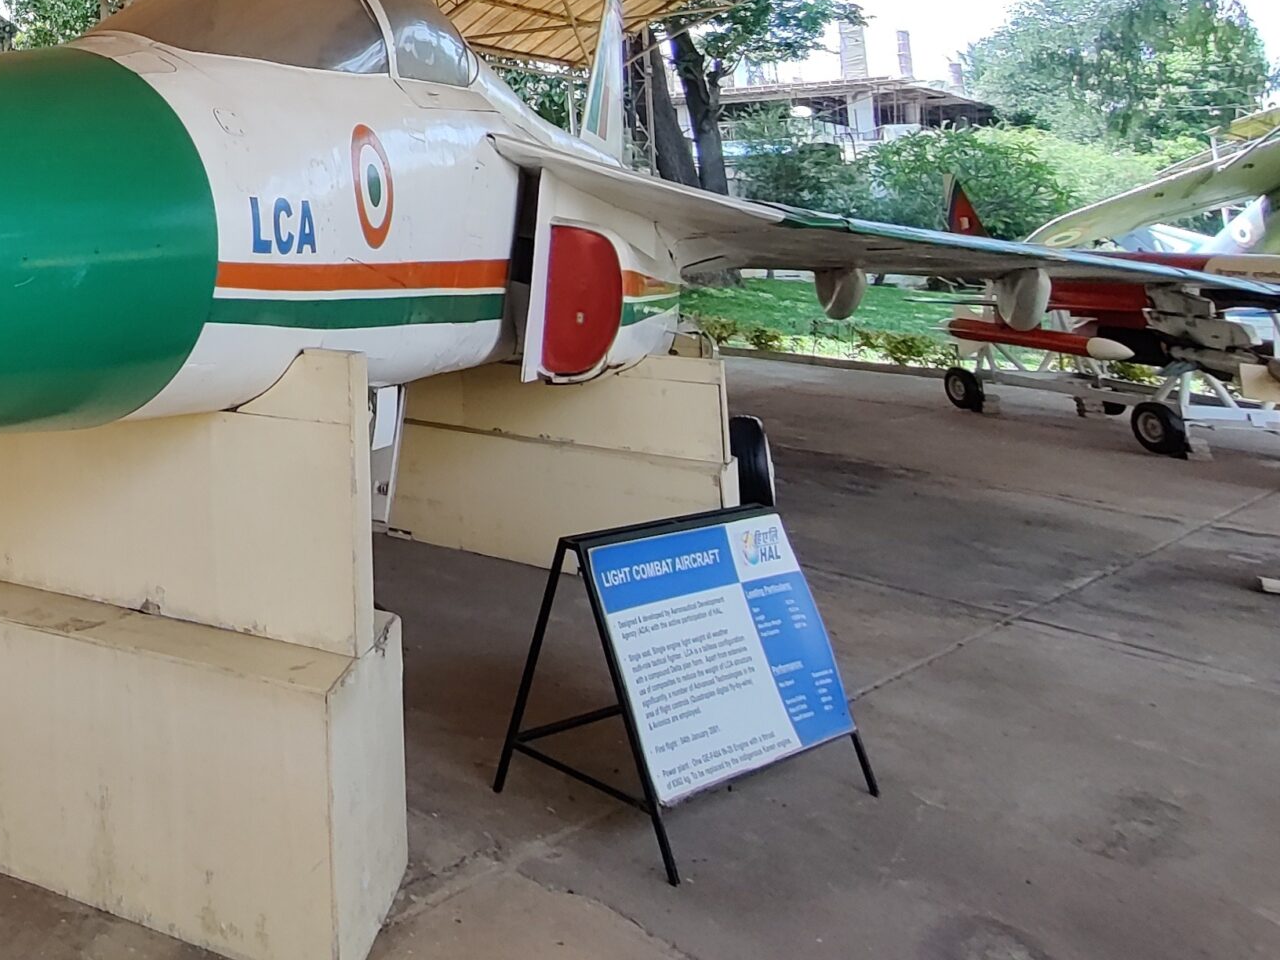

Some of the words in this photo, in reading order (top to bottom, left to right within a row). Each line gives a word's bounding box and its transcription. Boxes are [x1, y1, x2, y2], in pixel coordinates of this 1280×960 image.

[249, 197, 317, 255] LCA
[601, 567, 631, 587] LIGHT
[632, 558, 673, 580] COMBAT
[675, 549, 720, 571] AIRCRAFT
[760, 544, 781, 562] HAL
